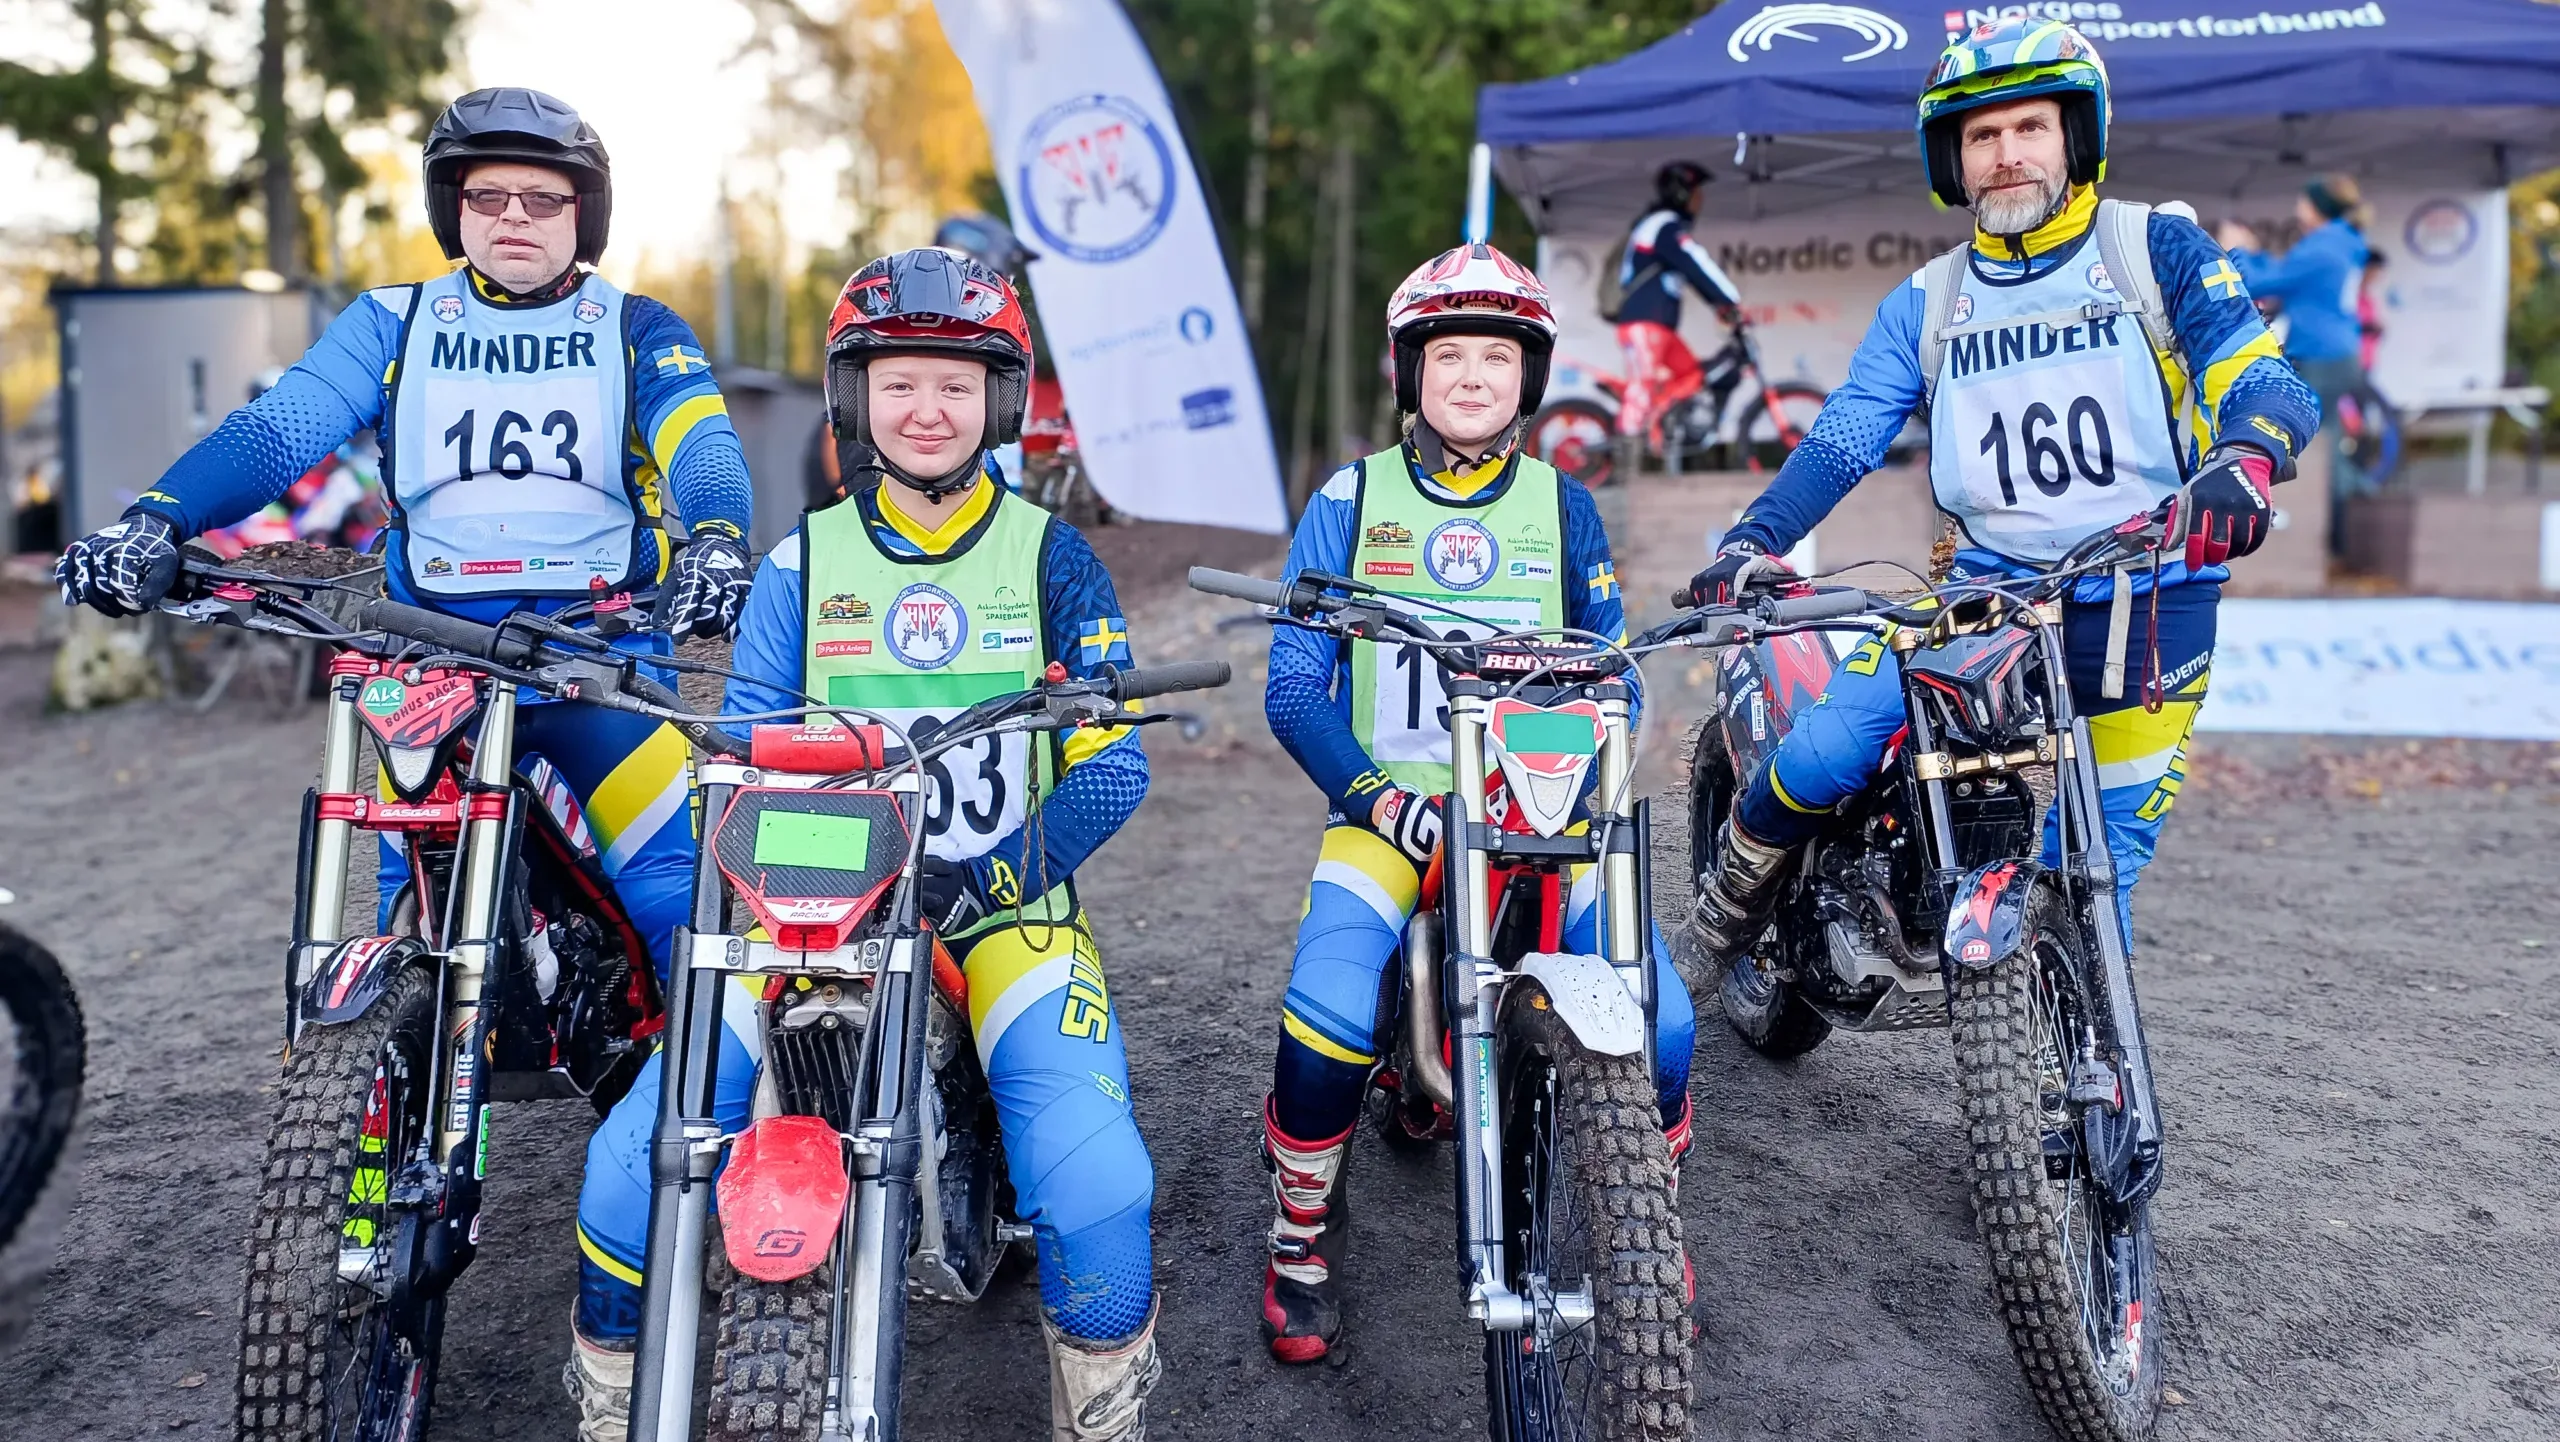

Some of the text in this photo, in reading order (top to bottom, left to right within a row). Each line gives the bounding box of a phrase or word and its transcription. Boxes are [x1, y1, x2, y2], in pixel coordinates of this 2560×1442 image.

[1966, 1, 2123, 29] Norges
[1720, 235, 1854, 275] Nordic
[431, 331, 597, 374] MINDER
[1951, 315, 2120, 379] MINDER
[444, 408, 583, 482] 163
[1980, 395, 2116, 507] 160
[1484, 654, 1595, 671] RENTHAL
[384, 679, 459, 728] BOHUS DÄCK
[791, 734, 846, 742] GASGAS
[380, 808, 442, 818] GASGAS
[789, 911, 830, 919] RACING
